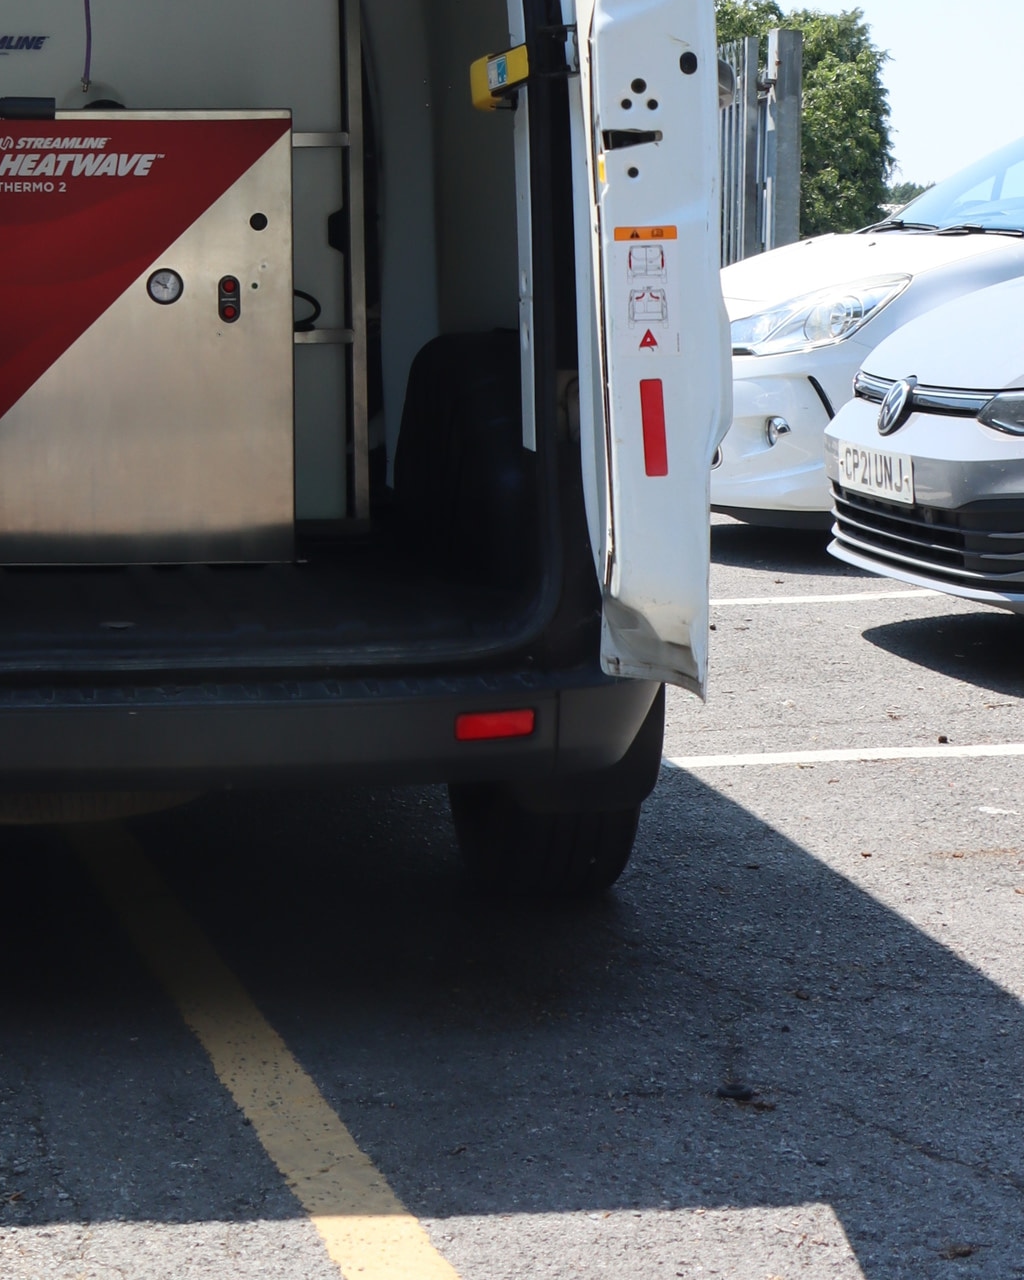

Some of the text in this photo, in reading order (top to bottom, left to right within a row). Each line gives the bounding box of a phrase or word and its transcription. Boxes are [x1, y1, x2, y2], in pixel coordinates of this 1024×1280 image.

[15, 137, 108, 150] STREAMLINE
[59, 182, 67, 193] 2
[874, 452, 903, 493] UNJ
